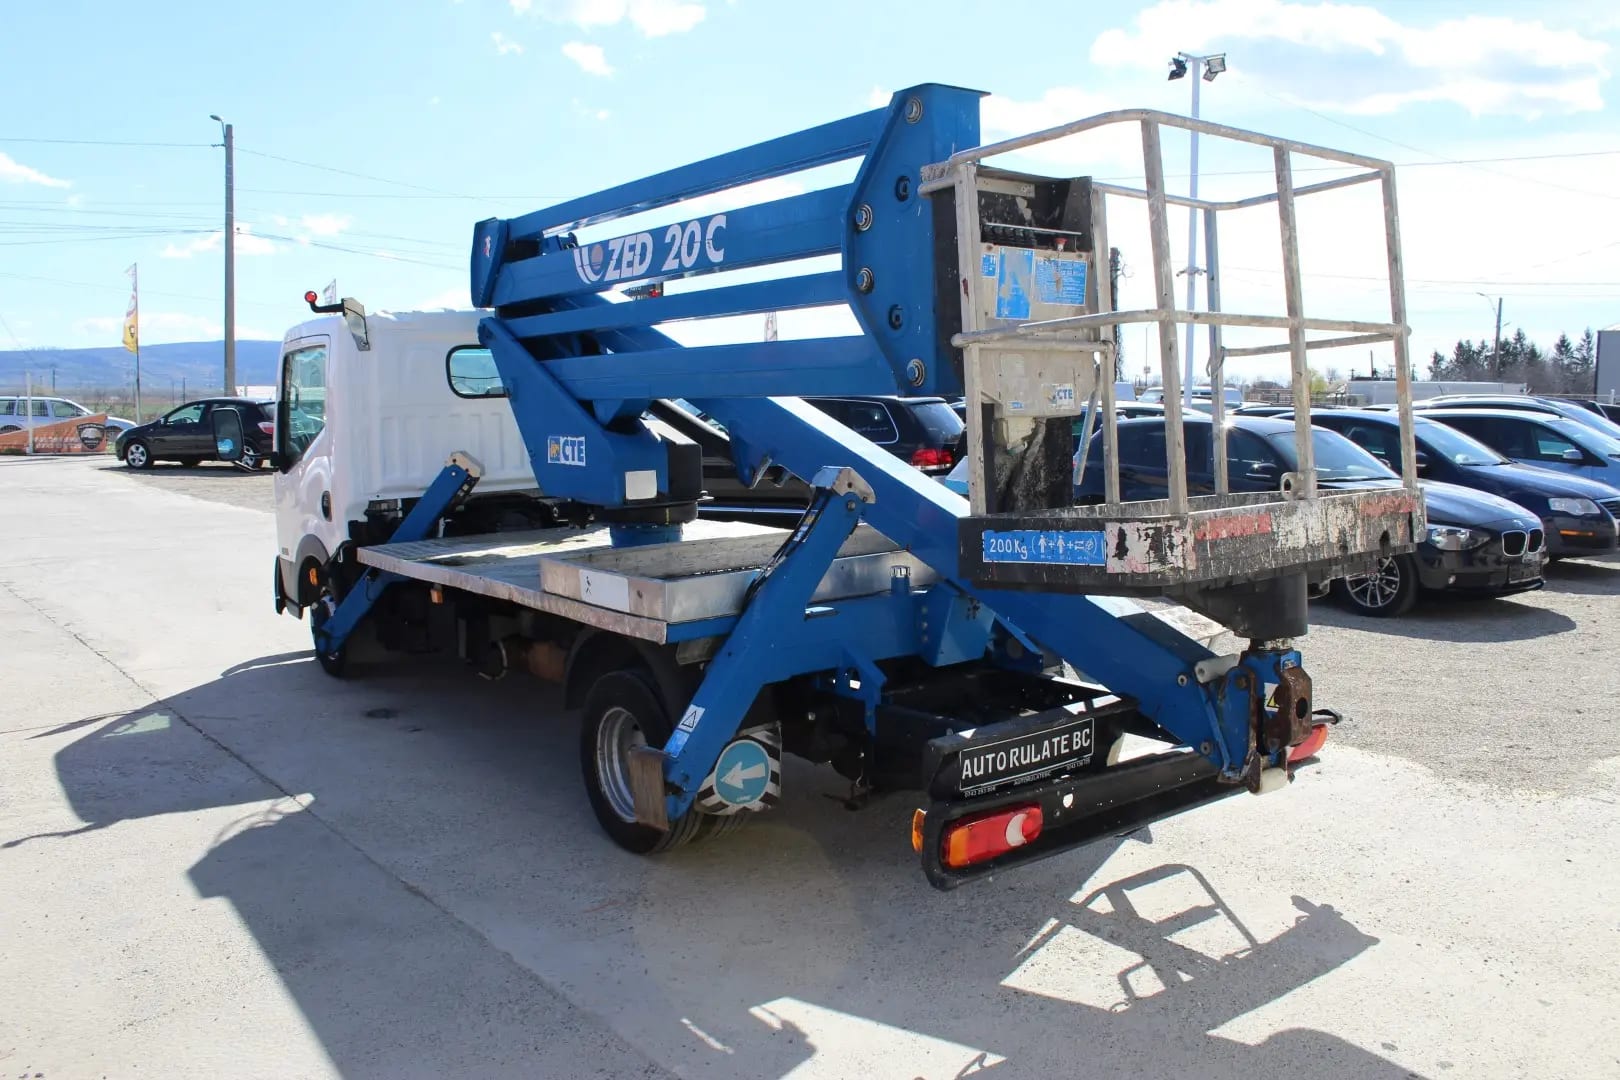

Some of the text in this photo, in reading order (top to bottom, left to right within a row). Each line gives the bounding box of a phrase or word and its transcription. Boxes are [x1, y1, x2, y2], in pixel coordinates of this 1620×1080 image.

[604, 232, 653, 281] ZED
[1056, 388, 1073, 400] CTE
[562, 438, 585, 463] CTE
[990, 538, 1012, 553] 200
[961, 734, 1070, 780] AUTORULATE
[1072, 728, 1091, 750] BC
